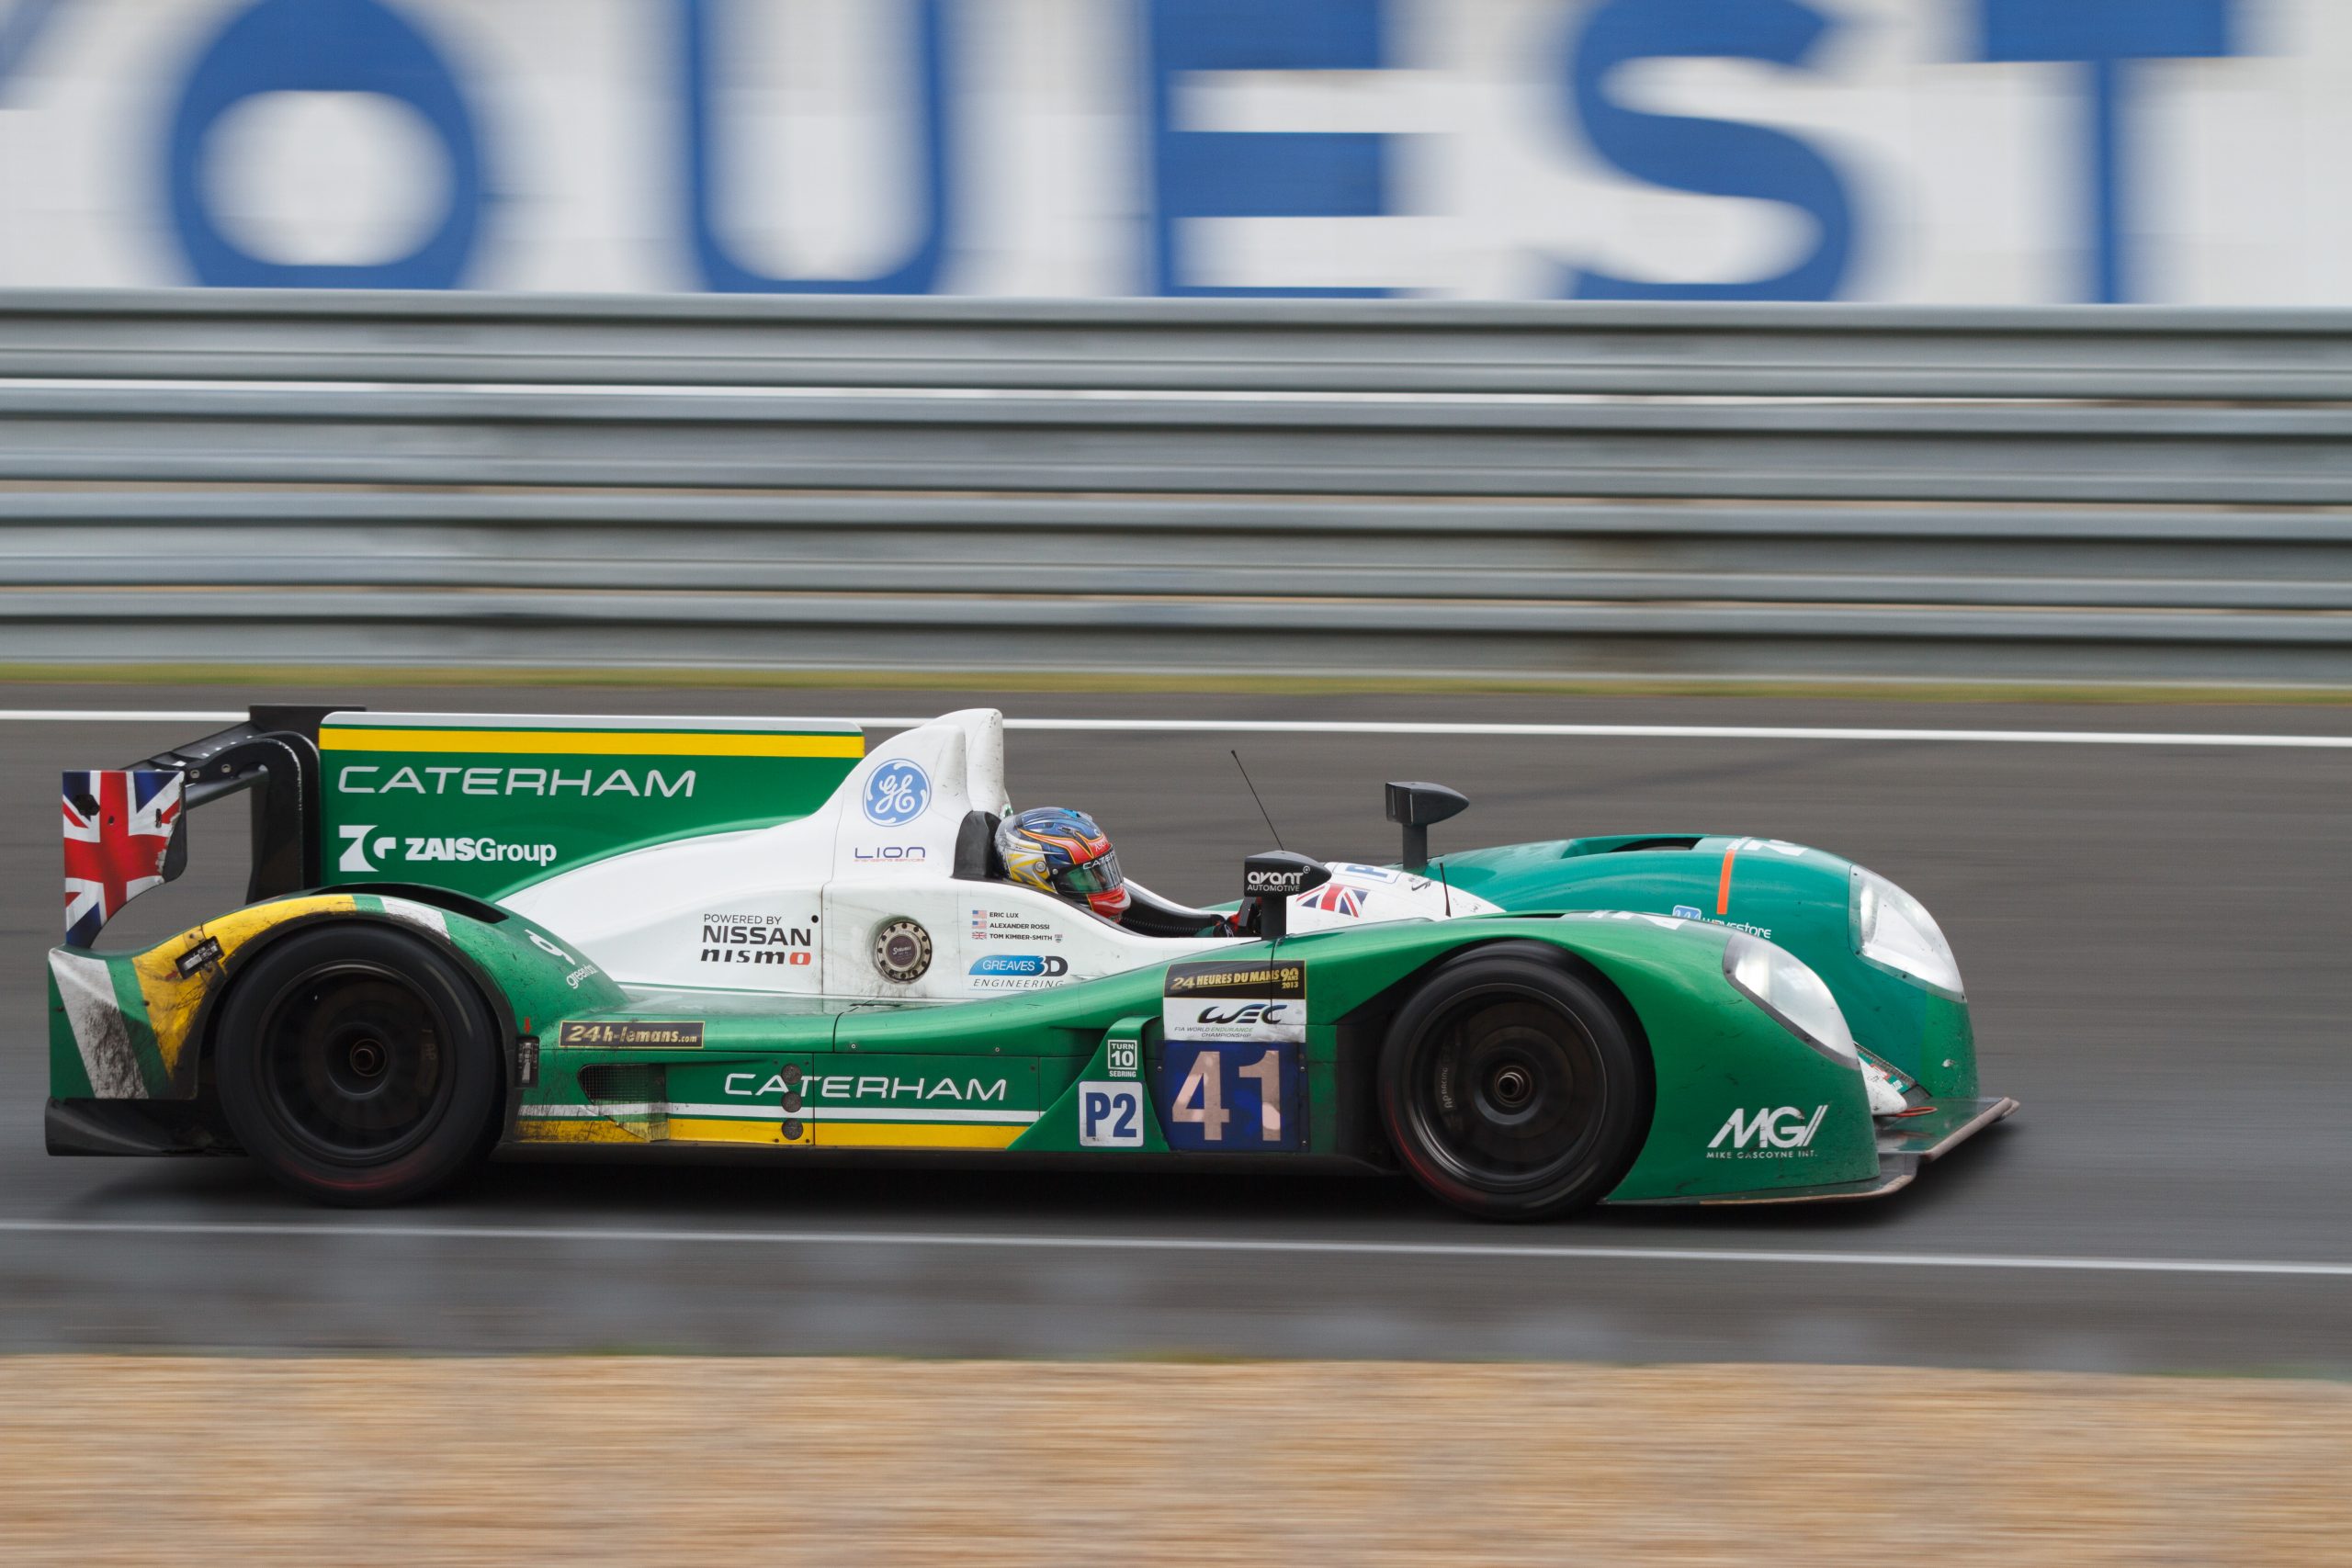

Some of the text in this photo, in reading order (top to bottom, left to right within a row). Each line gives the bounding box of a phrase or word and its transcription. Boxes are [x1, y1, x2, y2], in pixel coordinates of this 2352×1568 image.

[337, 765, 696, 797] CATERHAM
[405, 837, 557, 866] ZAISGroup
[1247, 884, 1301, 892] AUTOMOTIVE
[704, 913, 782, 925] POWERED BY
[702, 925, 811, 946] NISSAN
[701, 949, 811, 965] nismo
[982, 960, 1035, 971] GREAVES
[1170, 969, 1280, 989] 24 HEURES DU MANS
[1282, 981, 1299, 989] 2013
[1197, 1003, 1288, 1024] WEC
[1111, 1050, 1135, 1066] 10
[724, 1073, 1007, 1101] CATERHAM
[1172, 1050, 1282, 1142] 41
[1085, 1092, 1137, 1138] P2
